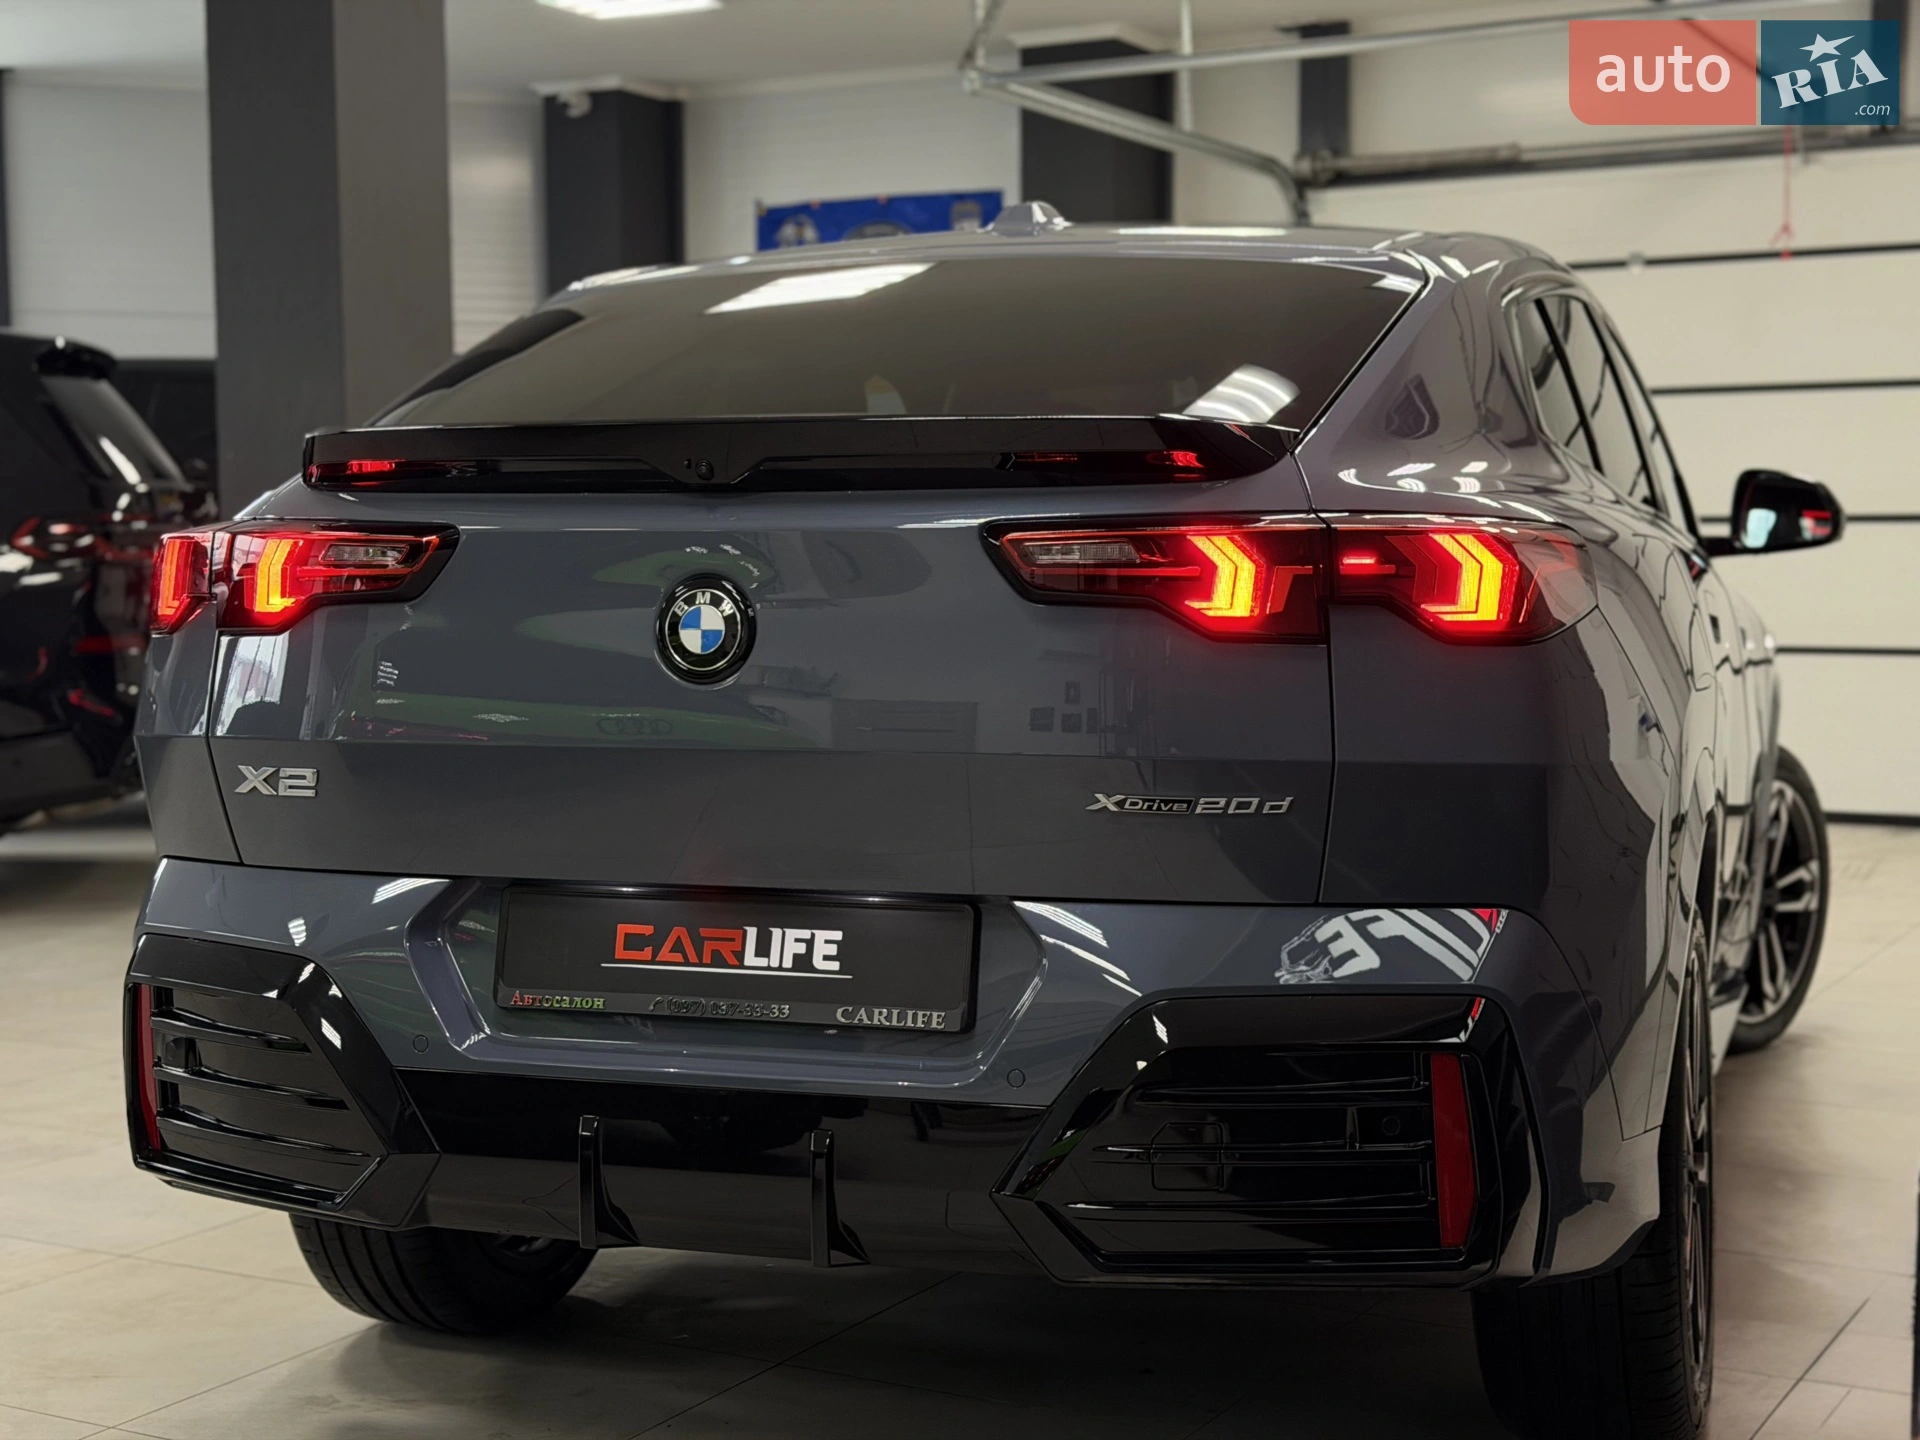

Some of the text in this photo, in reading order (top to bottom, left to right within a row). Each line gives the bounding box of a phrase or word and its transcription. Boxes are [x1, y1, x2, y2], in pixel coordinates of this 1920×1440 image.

[673, 591, 735, 617] BMW
[234, 764, 318, 797] X2
[614, 923, 843, 971] CARLIFE
[510, 990, 606, 1010] Автосалон
[836, 1006, 946, 1030] CARLIFE
